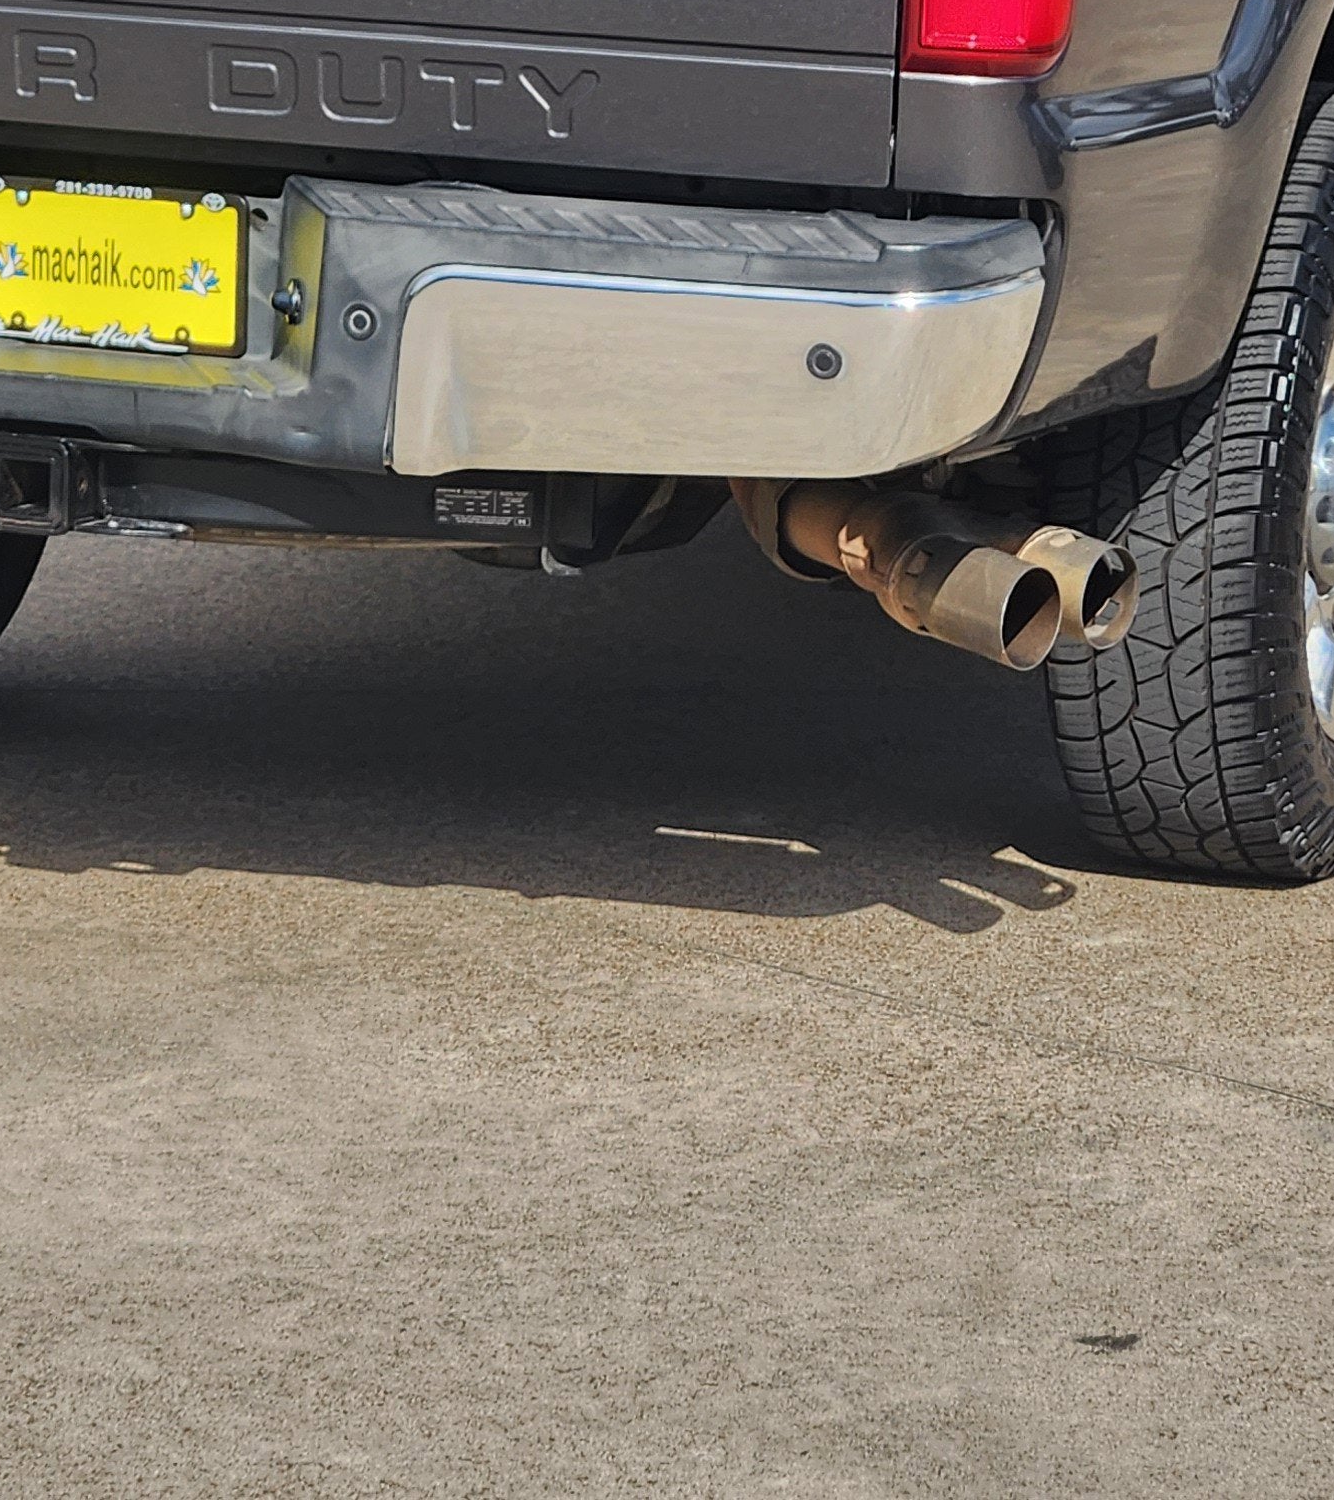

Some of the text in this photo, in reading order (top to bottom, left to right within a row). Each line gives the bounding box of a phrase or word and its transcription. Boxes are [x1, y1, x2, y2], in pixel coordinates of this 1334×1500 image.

[207, 42, 600, 139] DUTY
[31, 236, 175, 292] machaik.com
[20, 315, 165, 352] Mac Haik
